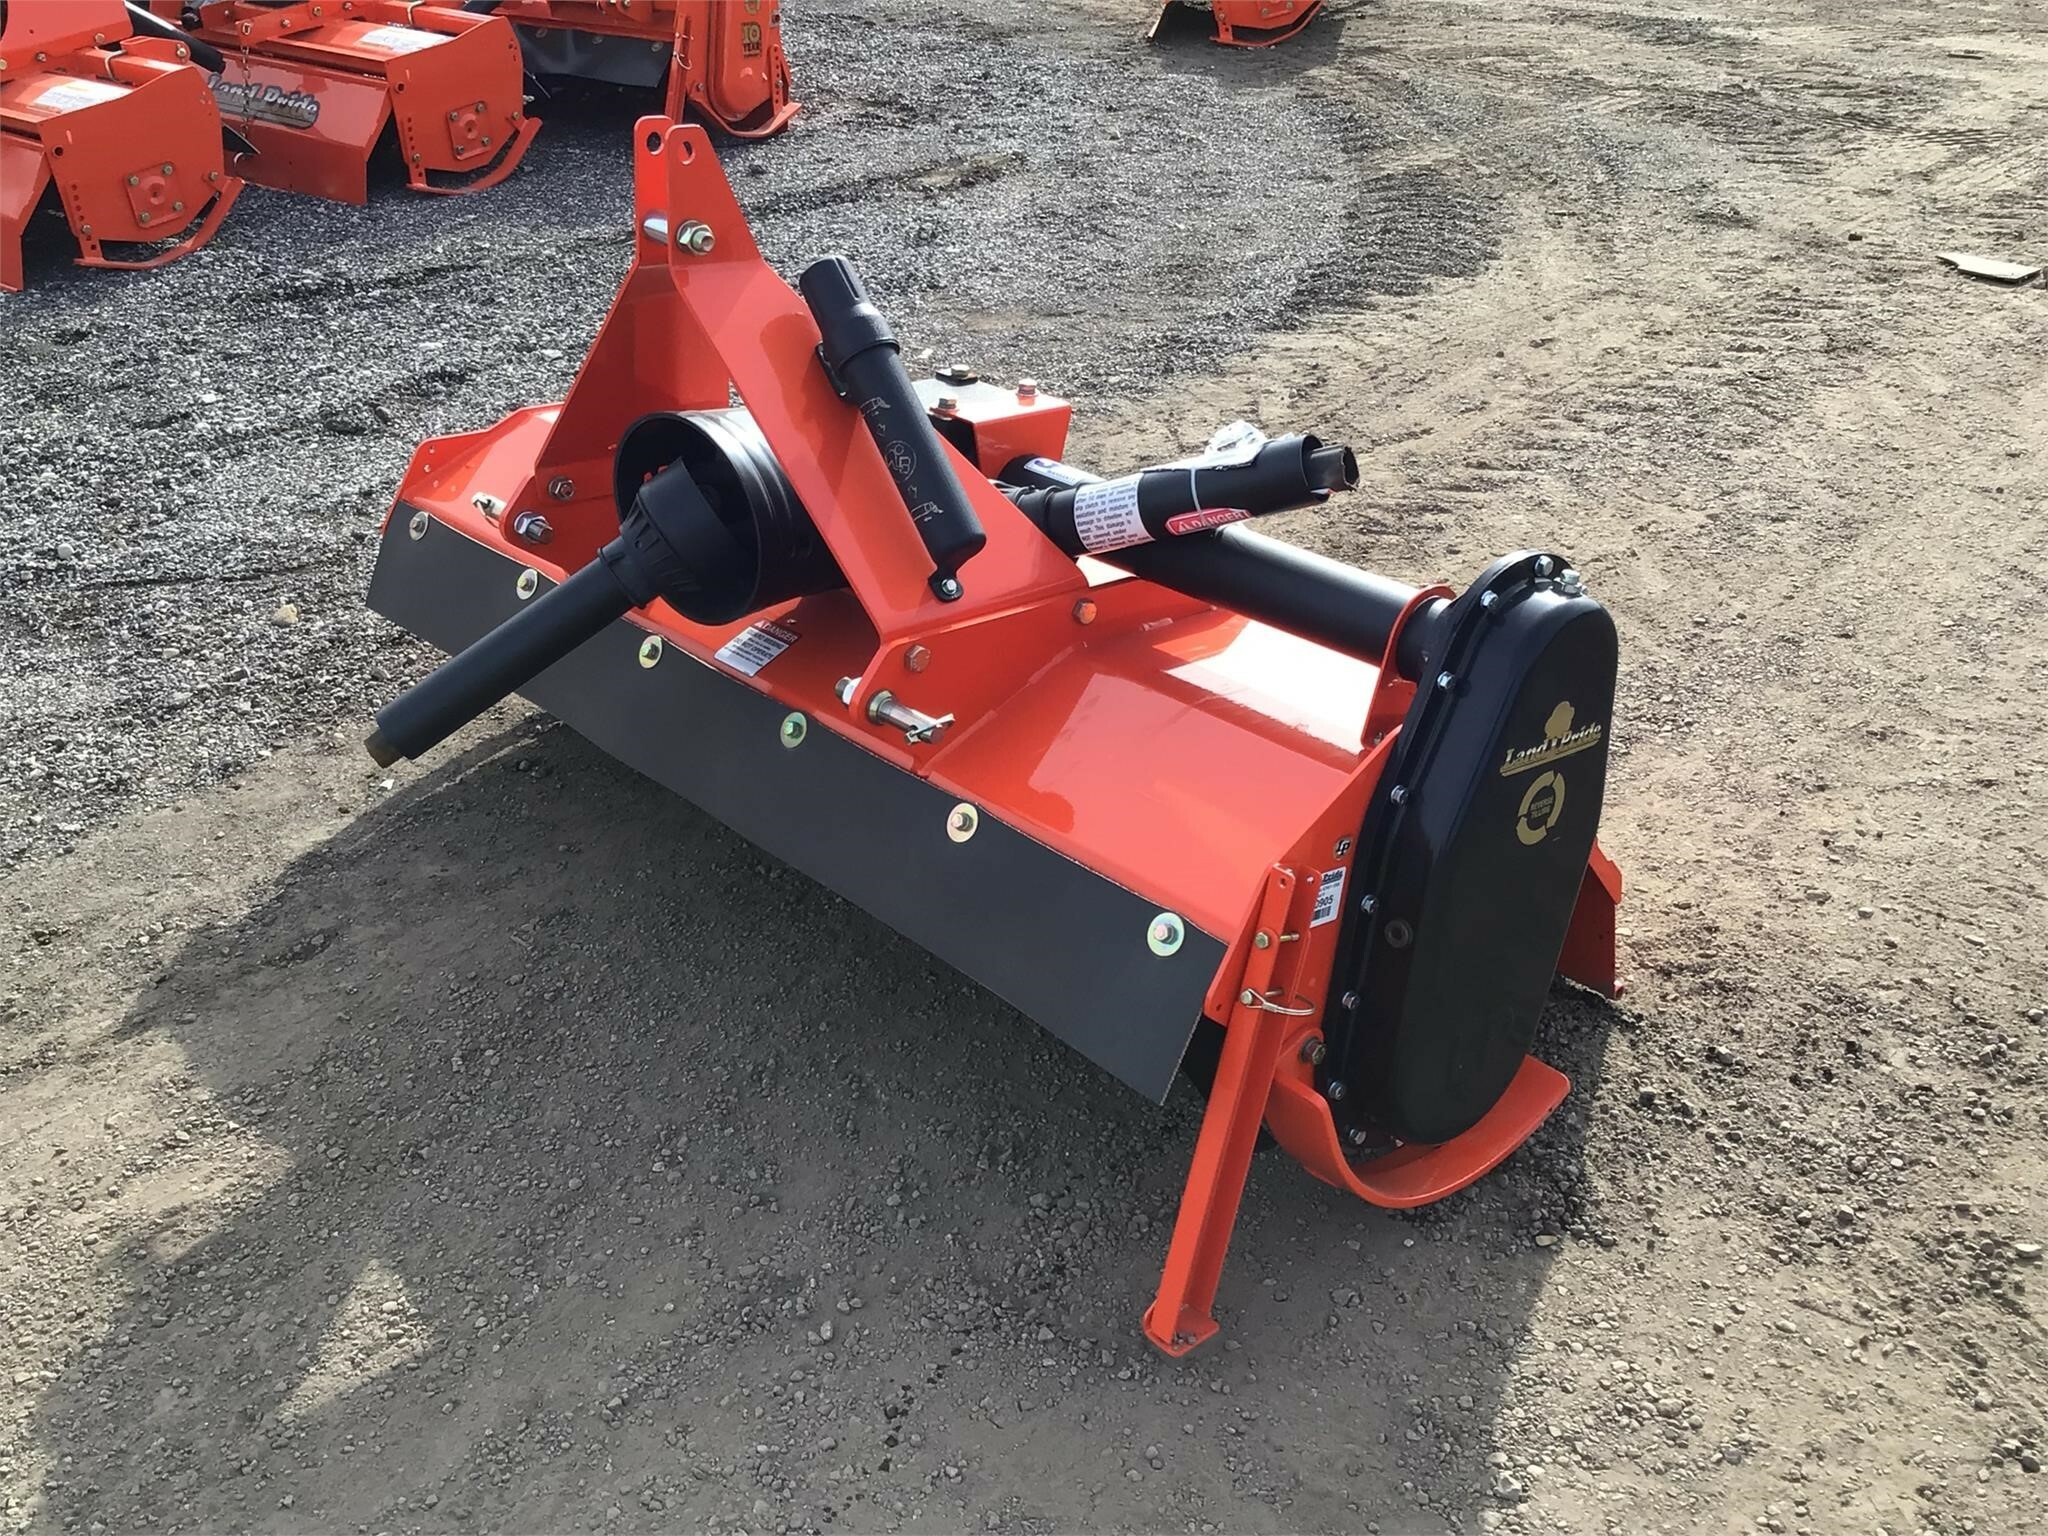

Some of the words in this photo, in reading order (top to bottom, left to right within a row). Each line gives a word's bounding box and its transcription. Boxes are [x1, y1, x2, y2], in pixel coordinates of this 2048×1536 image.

[763, 621, 799, 643] DANGER
[1503, 738, 1549, 768] Land
[1560, 722, 1602, 751] Pride
